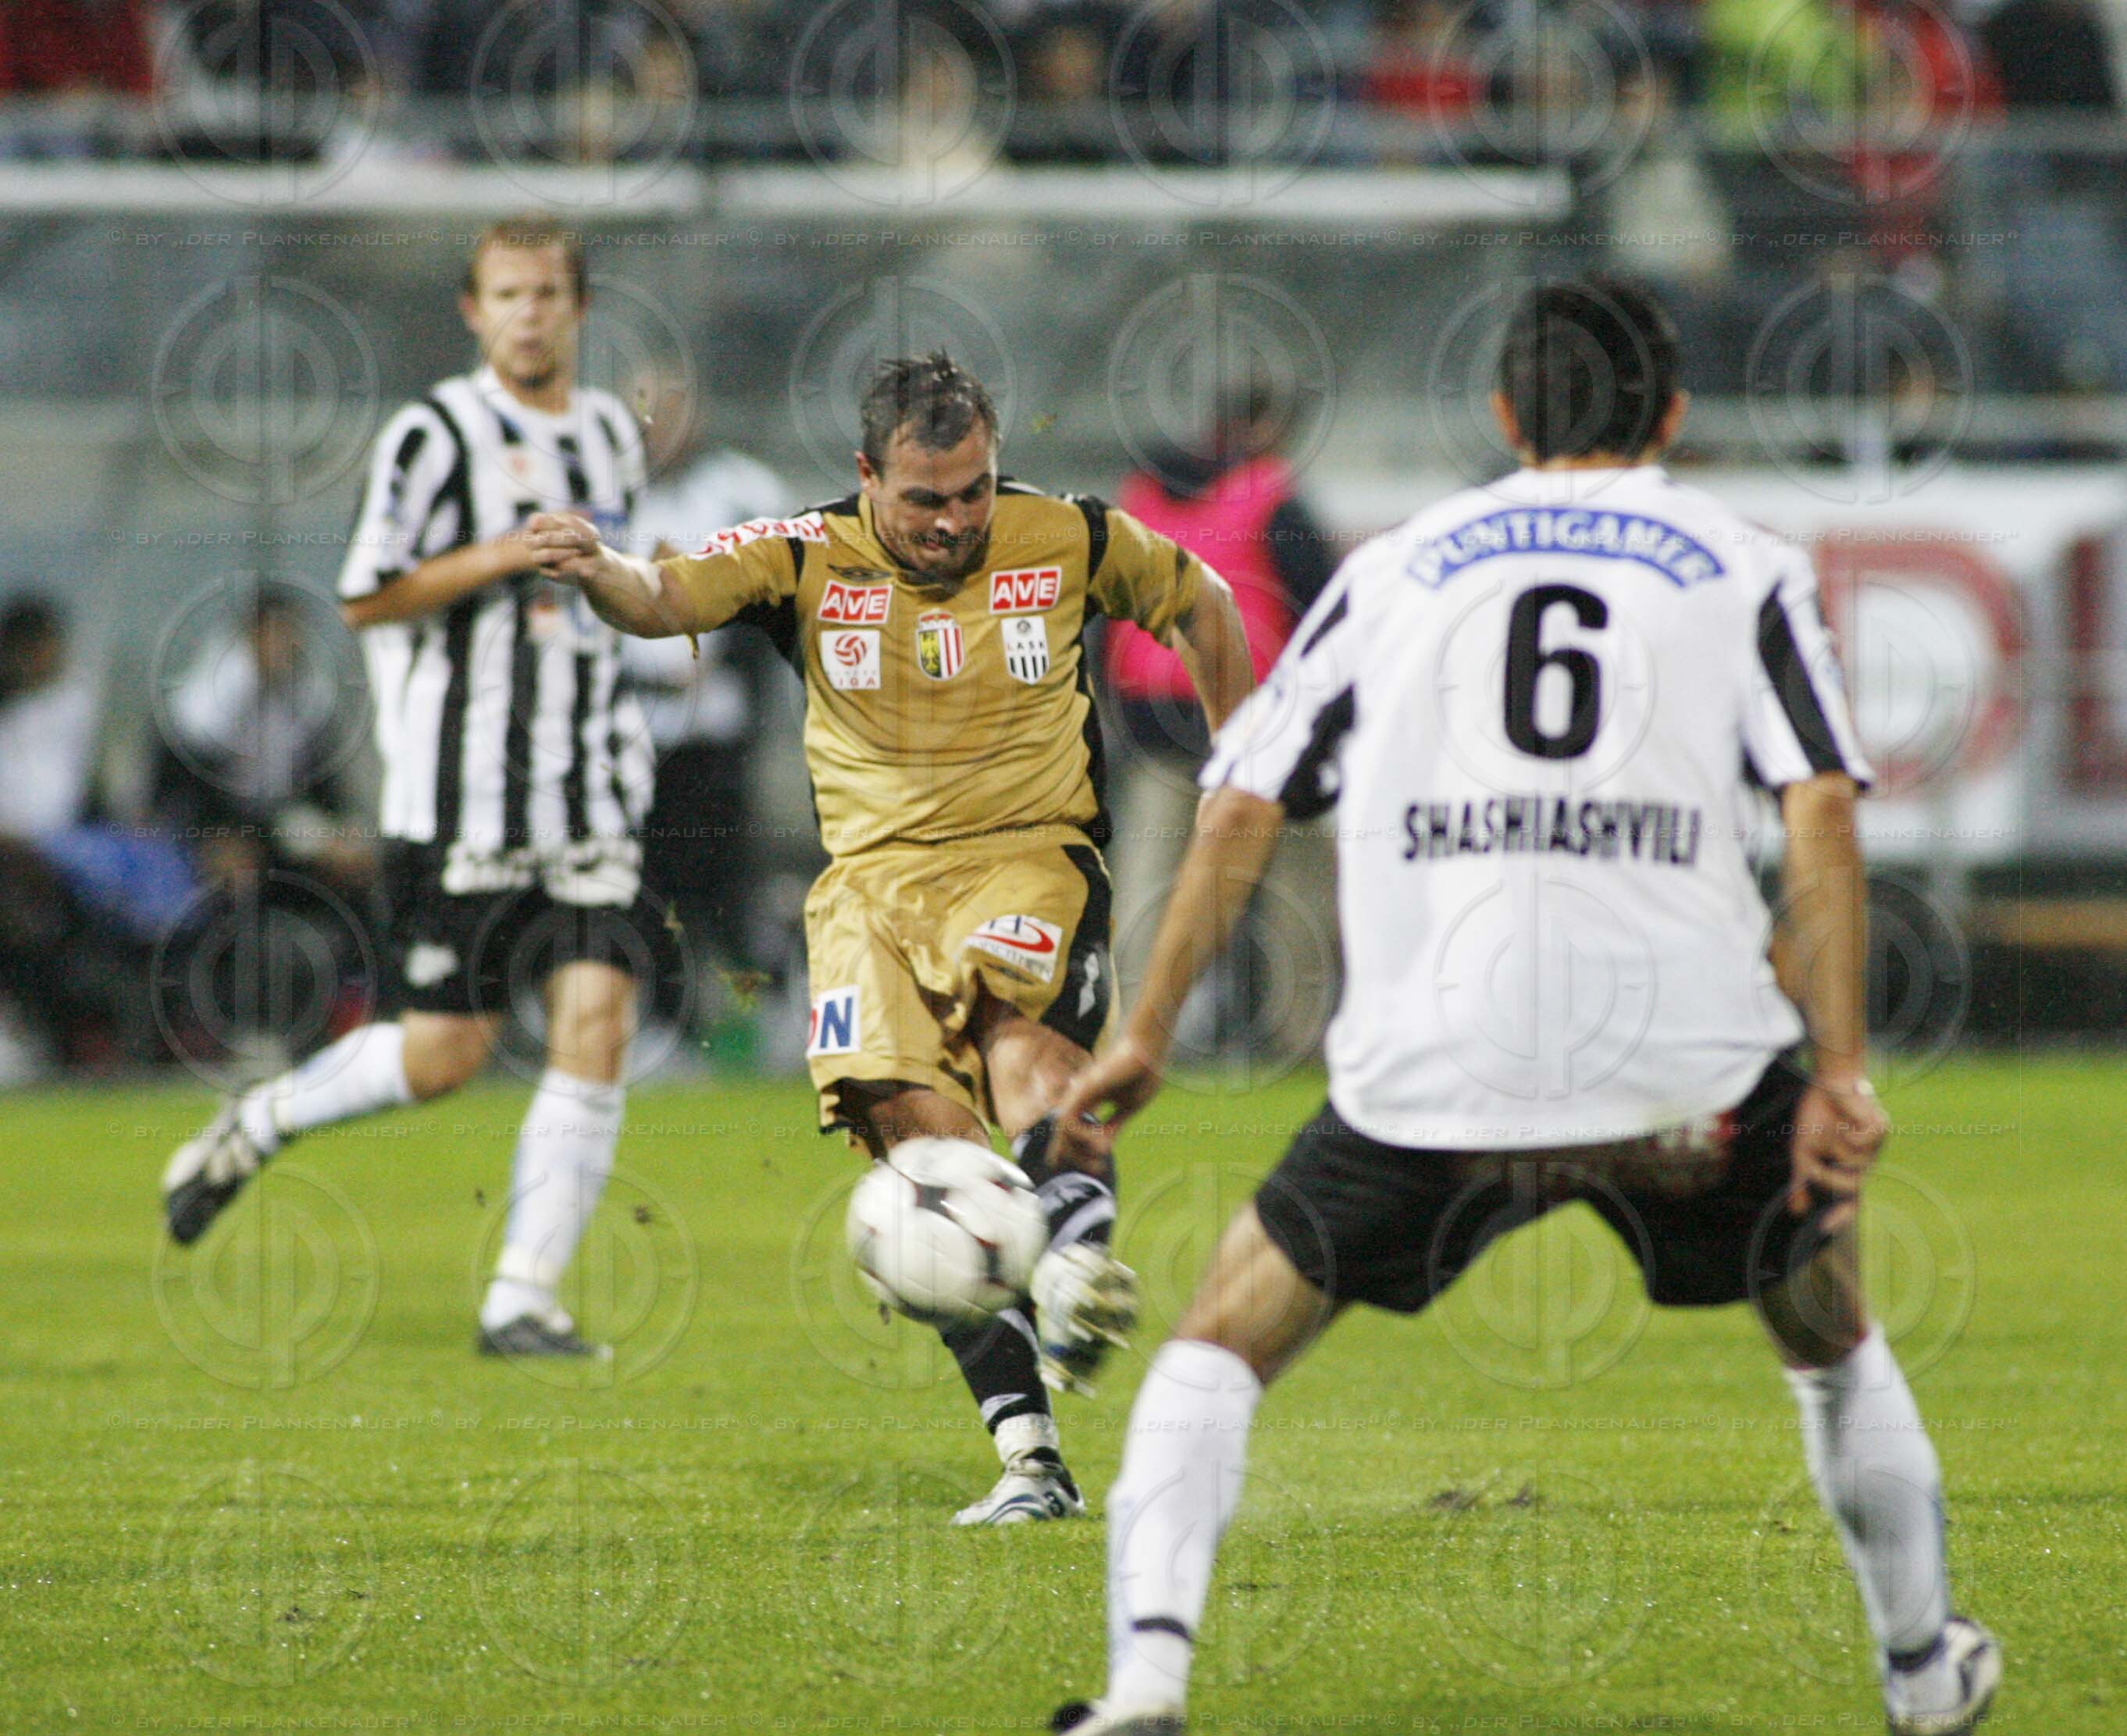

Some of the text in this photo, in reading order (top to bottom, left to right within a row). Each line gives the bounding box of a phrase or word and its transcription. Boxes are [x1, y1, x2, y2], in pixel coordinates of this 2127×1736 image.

[822, 590, 888, 616] AVE
[993, 577, 1057, 604] AVE
[1504, 583, 1609, 760] 6
[1402, 798, 1701, 865] SHASHIASHVILI
